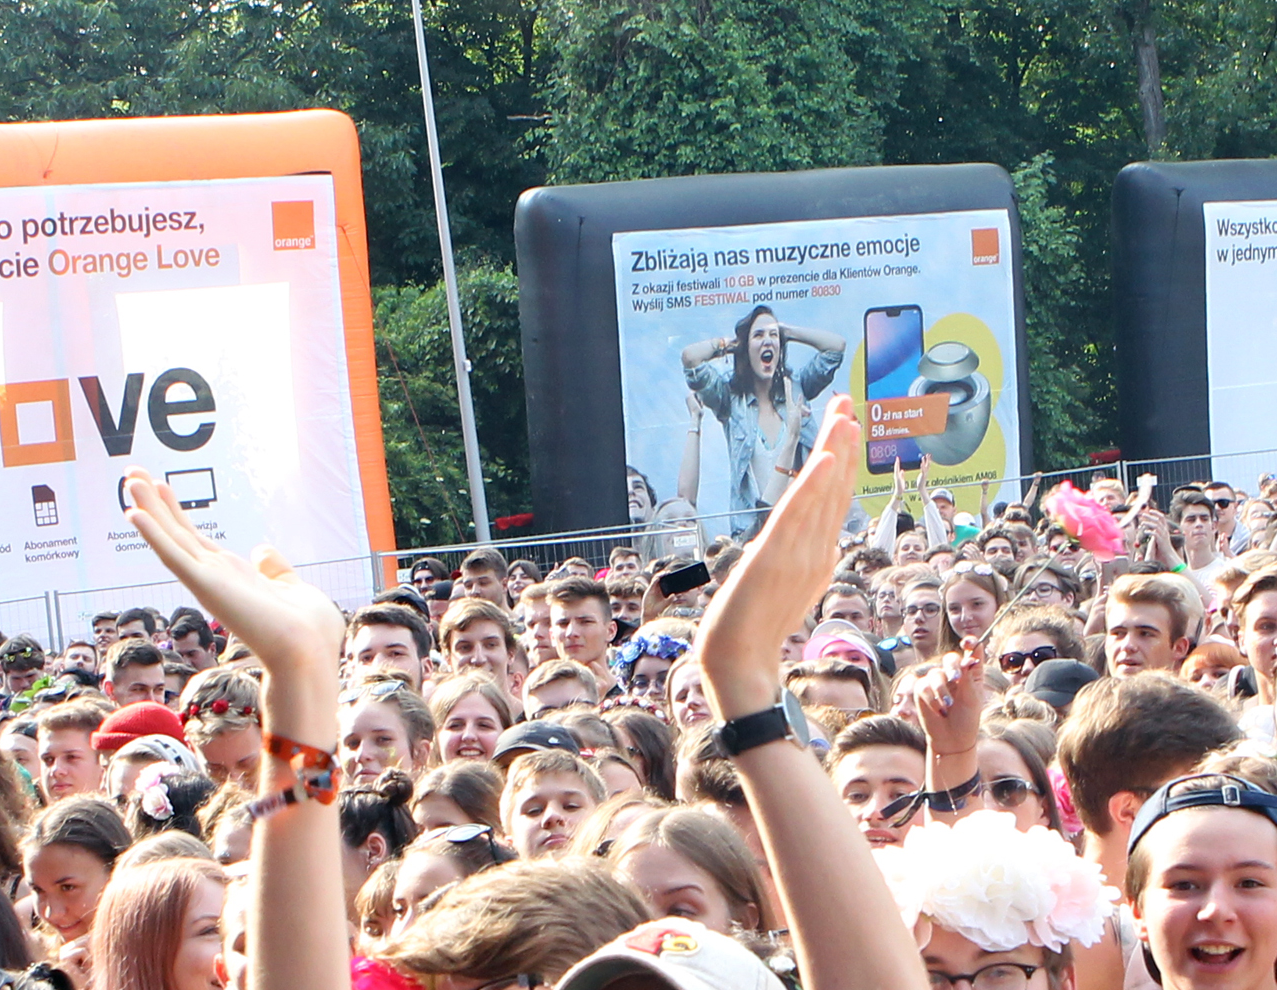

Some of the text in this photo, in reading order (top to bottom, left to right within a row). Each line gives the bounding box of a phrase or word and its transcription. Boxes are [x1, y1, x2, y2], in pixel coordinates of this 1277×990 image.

[22, 207, 205, 244] potrzebujesz,
[48, 248, 148, 278] Orange
[156, 244, 220, 269] Love
[631, 233, 920, 274] Zbliżają nas muzyczne emocje
[1217, 249, 1228, 262] w
[632, 264, 921, 296] Z okazji festiwali 10 GB w prezencie dla Klientów Orange.
[632, 284, 841, 312] Wyślij SMS FESTIWAL pod numer 80830
[871, 404, 882, 422] 0
[892, 411, 903, 420] na
[904, 408, 923, 419] start
[871, 425, 885, 437] 58
[194, 520, 218, 531] wizja
[107, 530, 142, 541] Abona
[214, 531, 227, 540] 4K
[24, 536, 77, 551] Abonament
[25, 548, 79, 563] komórkowy
